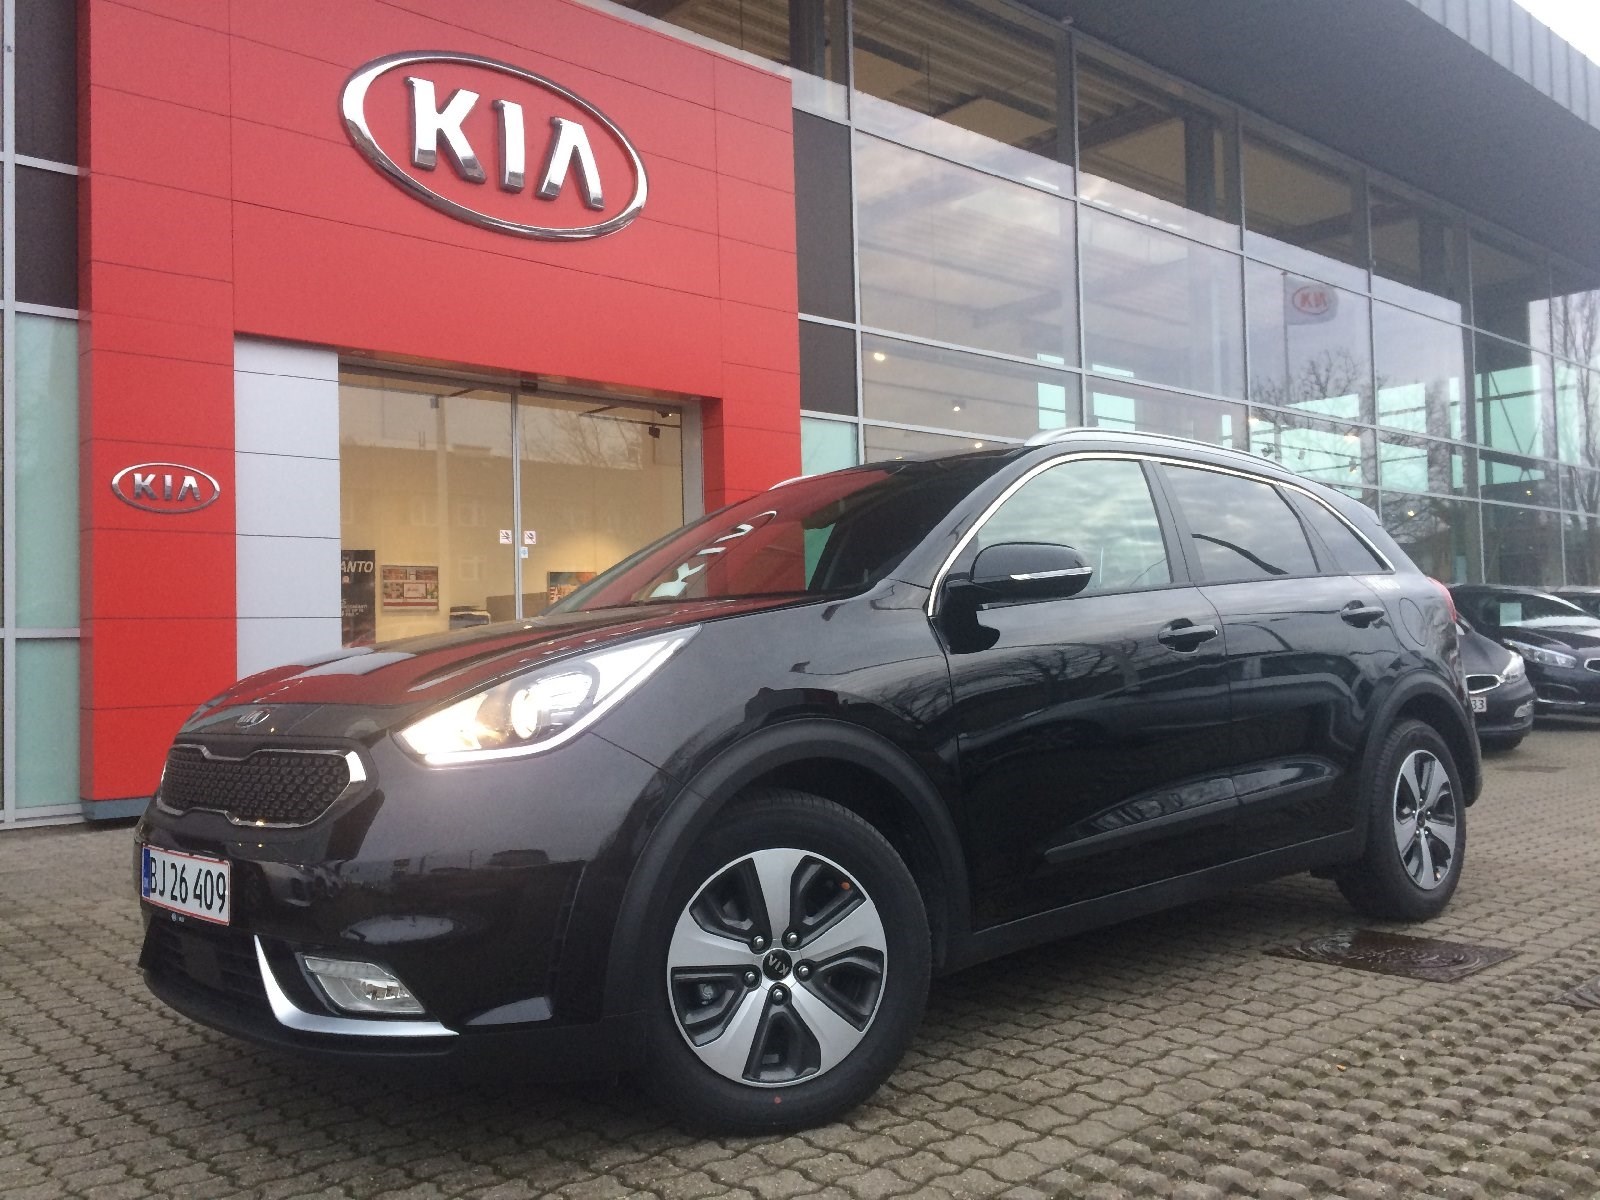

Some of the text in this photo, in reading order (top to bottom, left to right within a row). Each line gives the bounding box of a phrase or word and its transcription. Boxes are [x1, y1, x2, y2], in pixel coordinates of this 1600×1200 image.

[404, 76, 605, 211] KIA
[1300, 291, 1328, 308] KIA
[132, 472, 201, 501] KIA
[236, 710, 264, 724] KIA
[150, 856, 226, 914] BJ 26 409
[768, 953, 790, 976] KIA
